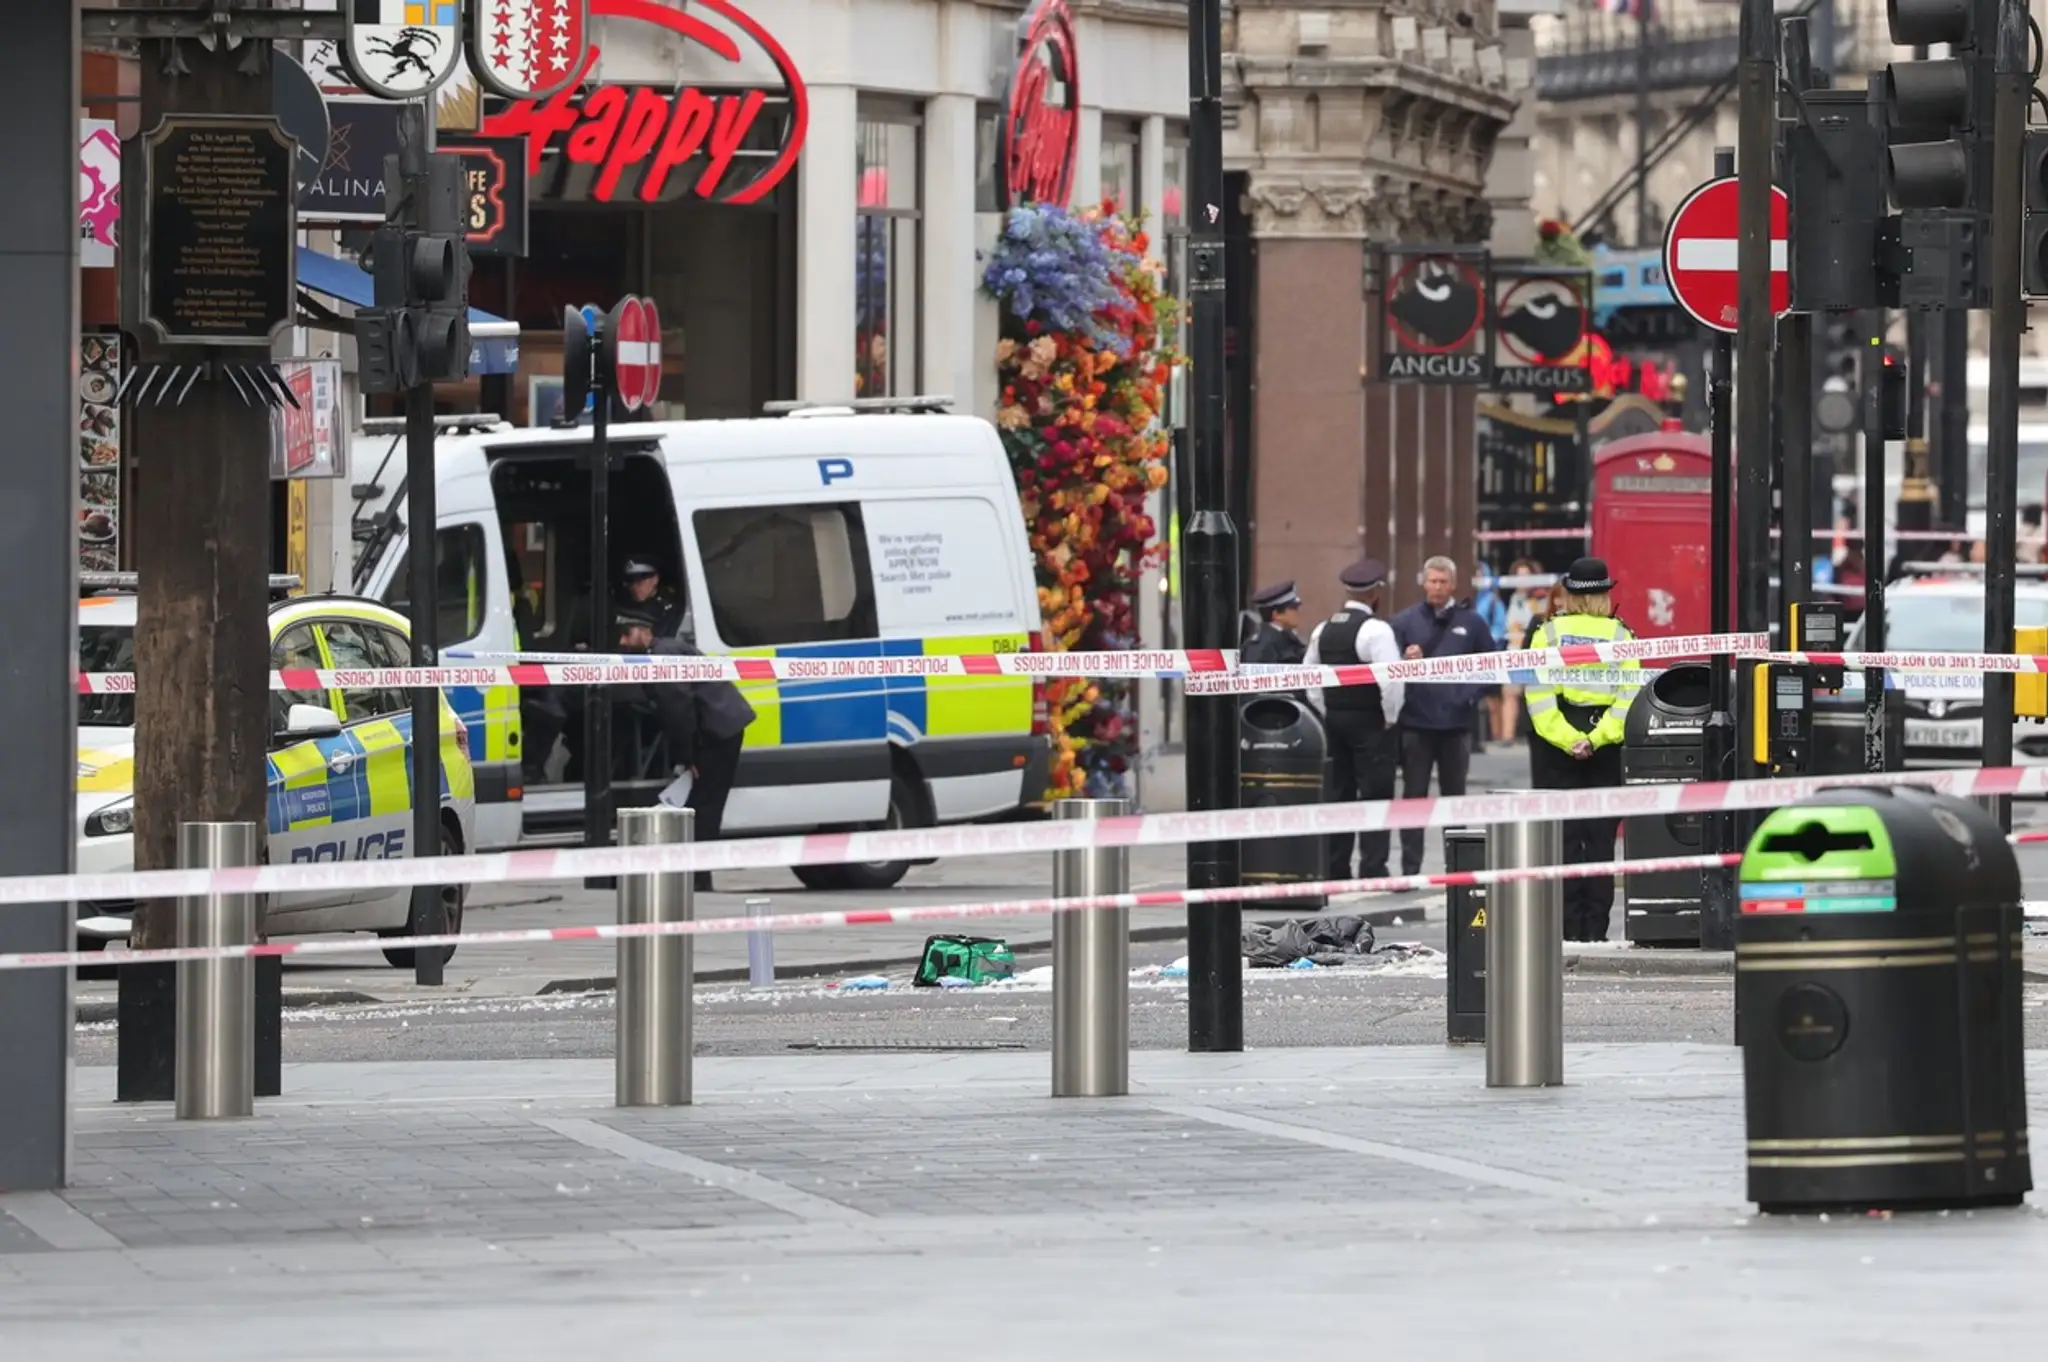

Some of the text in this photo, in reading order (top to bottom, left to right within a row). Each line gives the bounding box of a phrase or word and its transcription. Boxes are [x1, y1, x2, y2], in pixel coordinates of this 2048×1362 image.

[474, 45, 767, 202] Happy
[1388, 355, 1481, 376] ANGUS
[1500, 368, 1584, 386] ANGUS
[817, 458, 854, 485] P
[1612, 642, 1650, 659] CROSS
[1656, 640, 1679, 656] NOT
[1682, 638, 1699, 653] DO
[1703, 636, 1729, 651] LINE
[787, 658, 948, 677] POLICE LINE DO NOT CROSS
[1014, 653, 1174, 672] POLICE LINE DO NOT CROSS
[1429, 659, 1455, 675] NOT
[1457, 657, 1473, 673] DO
[1477, 654, 1503, 671] LINE
[1506, 651, 1547, 669] POLICE
[1902, 655, 1926, 667] NOT
[1930, 655, 1945, 668] DO
[1949, 656, 1975, 668] LINE
[1979, 656, 2020, 669] POLICE
[334, 669, 496, 686] POLICE LINE DO NOT CROSS
[561, 663, 723, 682] POLICE LINE DO NOT CROSS
[1387, 663, 1427, 679] CROSS
[1549, 669, 1580, 682] POLICE
[1583, 669, 1603, 683] LINE
[1606, 669, 1619, 683] DO
[1621, 669, 1640, 683] NOT
[105, 675, 136, 691] ROSS
[1903, 674, 1977, 688] POLICE LINE DO
